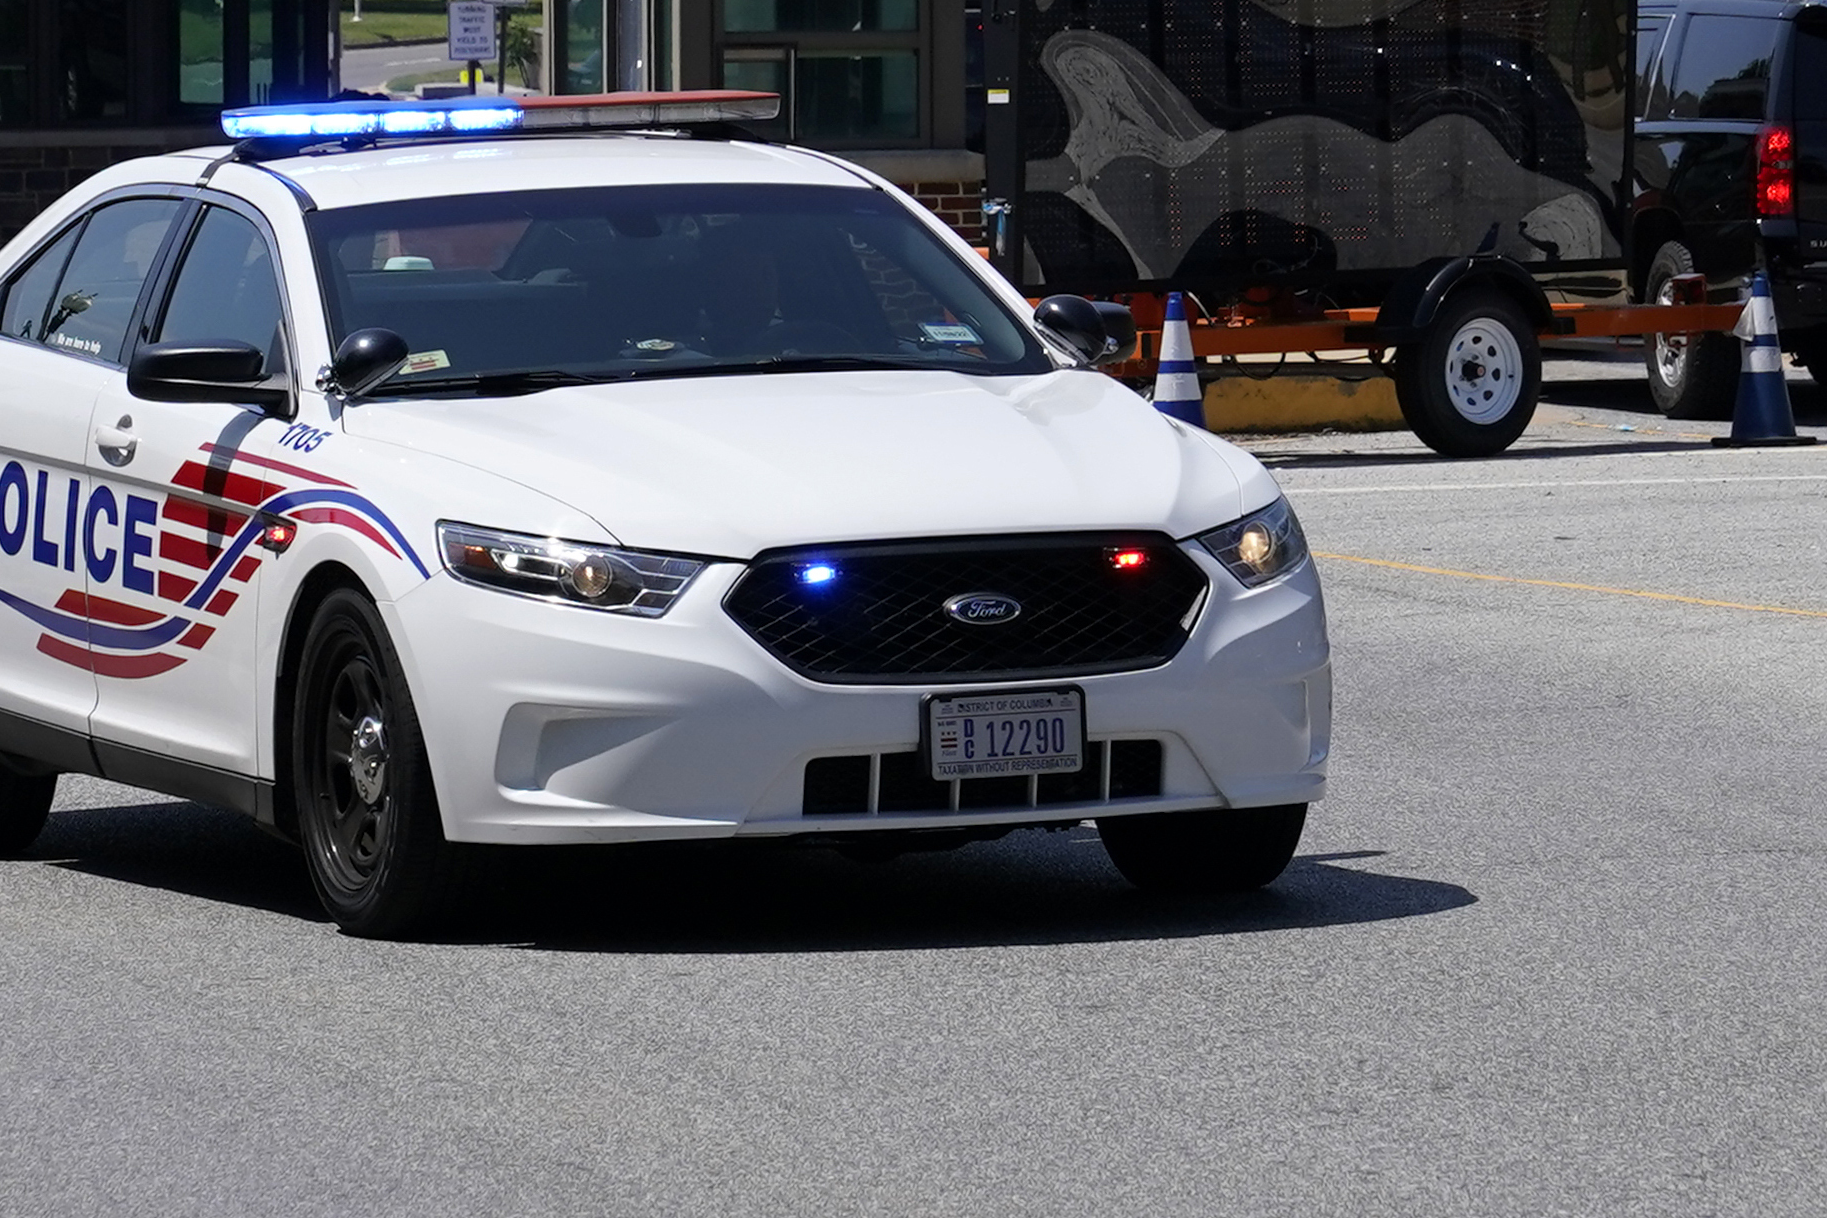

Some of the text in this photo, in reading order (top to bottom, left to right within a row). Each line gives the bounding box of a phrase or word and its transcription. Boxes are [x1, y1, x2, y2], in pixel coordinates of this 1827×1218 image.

[278, 422, 333, 453] 1705
[967, 600, 1007, 618] Ford
[997, 700, 1008, 711] OF
[986, 718, 1065, 758] 12290
[976, 761, 1009, 773] WITHOUT
